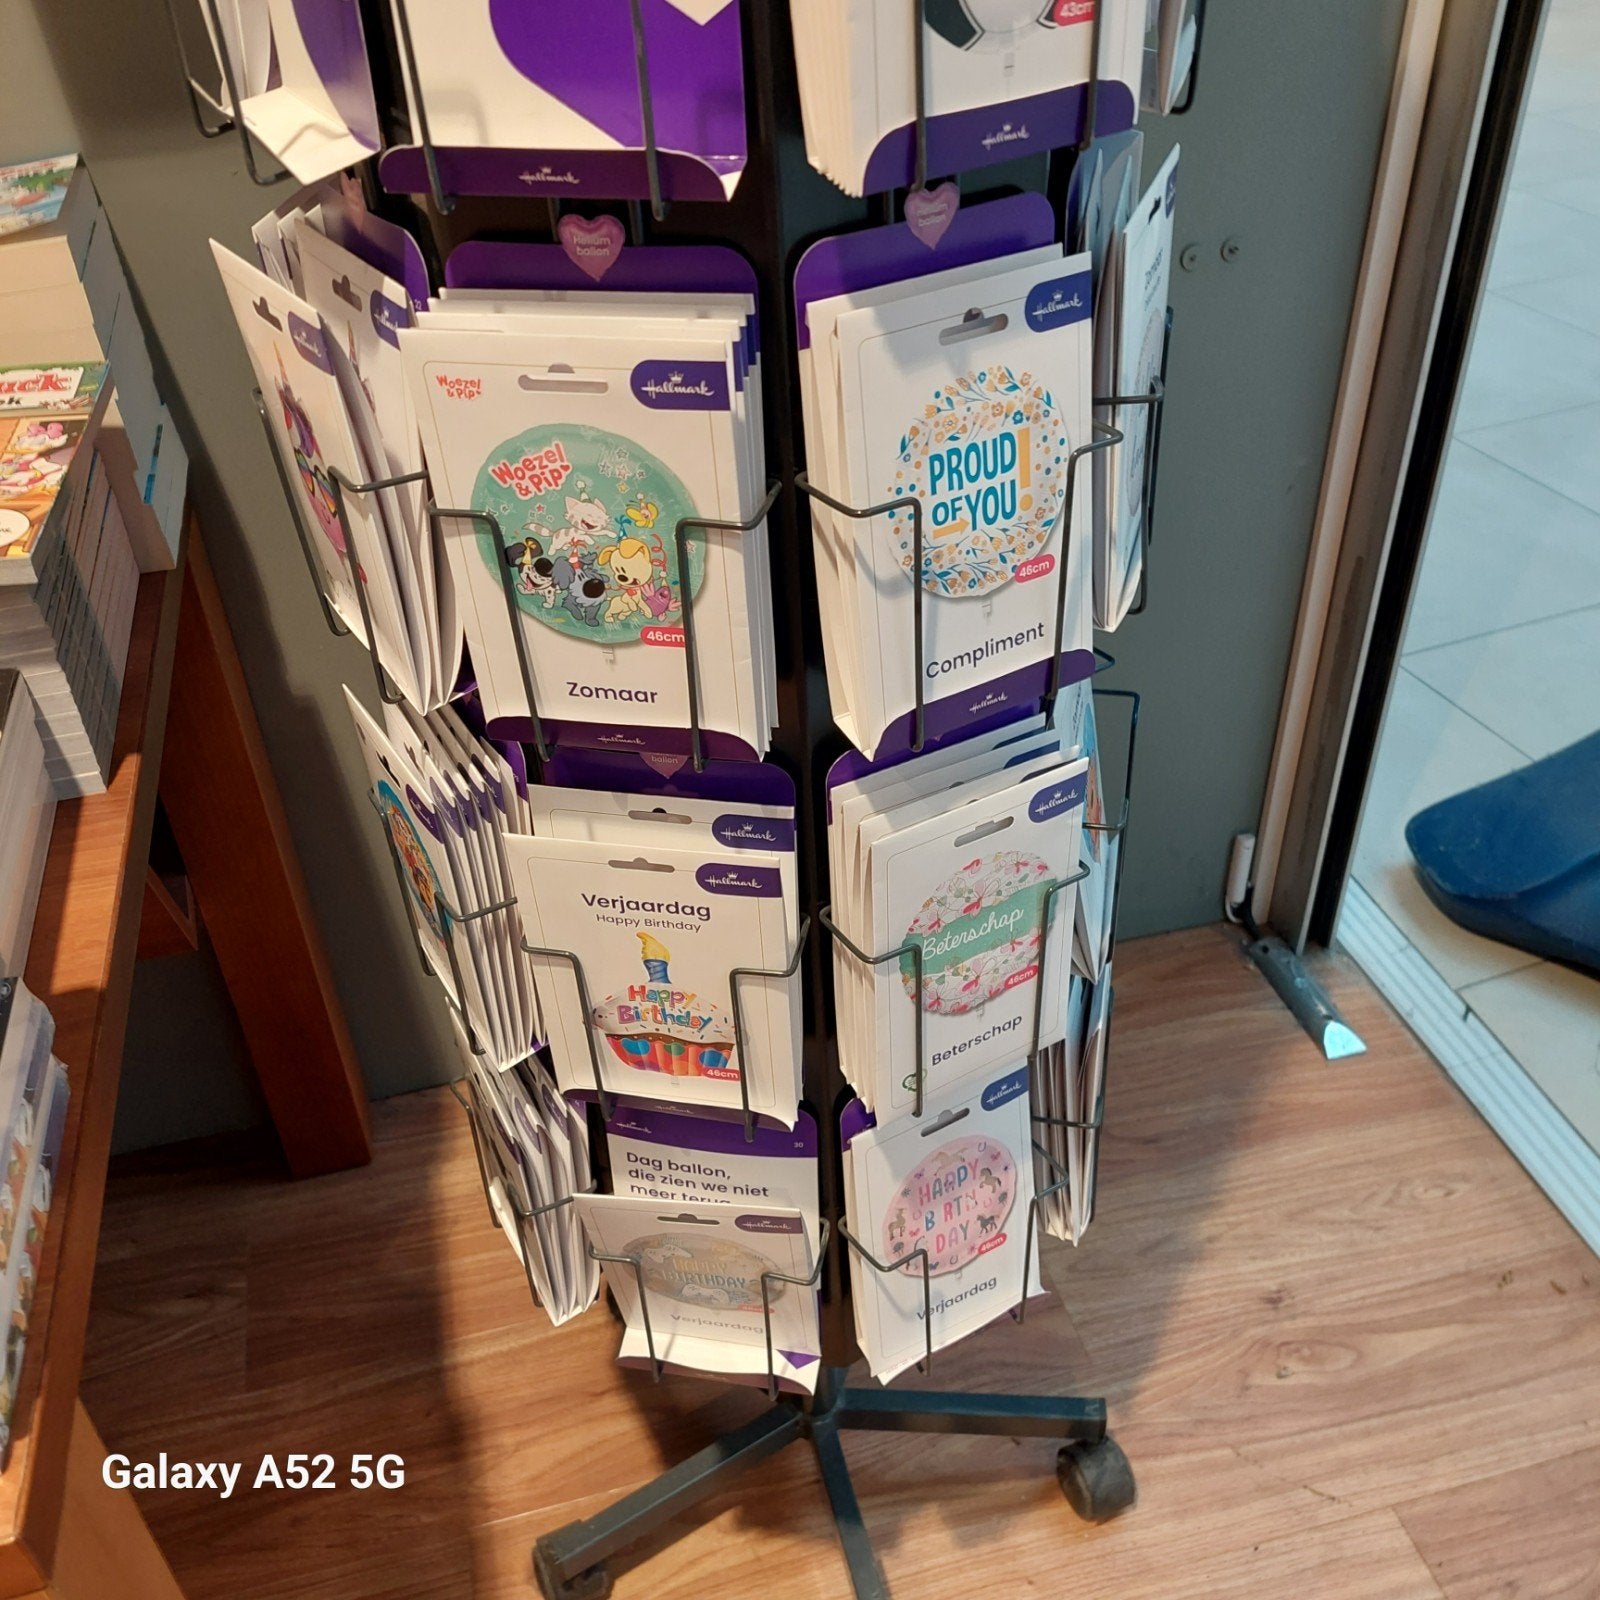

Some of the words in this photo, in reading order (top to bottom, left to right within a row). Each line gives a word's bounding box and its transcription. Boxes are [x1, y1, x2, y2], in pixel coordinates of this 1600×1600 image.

[981, 126, 1030, 151] Hallmark
[519, 170, 580, 185] Hallmark
[576, 245, 611, 257] ballon
[1032, 297, 1084, 322] Hallmark
[436, 375, 481, 390] Woezel
[641, 377, 715, 397] Hallmark
[491, 442, 565, 485] Woezel
[929, 431, 1017, 496] PROUD
[516, 483, 531, 497] &
[529, 465, 563, 495] Pip
[931, 497, 963, 527] OF
[961, 479, 1017, 532] YOU
[1018, 560, 1051, 579] 46cm
[646, 630, 686, 643] 46cm
[926, 622, 1045, 679] Compliment
[566, 681, 659, 704] Zomaar
[969, 692, 1008, 714] Hallmark
[597, 735, 646, 747] Hallmark
[651, 756, 679, 764] ballon
[1035, 790, 1080, 816] Hallmark
[720, 827, 777, 842] Hallmark
[704, 875, 763, 889] Hallmark
[580, 893, 712, 922] Verjaardag
[595, 913, 641, 928] Happy
[643, 917, 702, 933] Birthday
[921, 908, 1024, 961] Beterschap
[1007, 968, 1035, 985] 46cm
[627, 984, 697, 1009] Happy
[617, 1004, 713, 1032] Birthday
[931, 1015, 1023, 1066] Beterschap
[706, 1068, 740, 1080] 46cm
[986, 1080, 1022, 1105] Hallmark
[626, 1151, 663, 1171] Dag
[667, 1158, 732, 1180] ballon,
[628, 1168, 656, 1182] die
[660, 1174, 696, 1190] zien
[701, 1181, 728, 1194] we
[733, 1184, 770, 1198] niet
[630, 1184, 677, 1200] meer
[918, 1158, 980, 1207] HAPPY
[936, 1219, 971, 1254] DAY
[670, 1313, 764, 1334] Verjaardag
